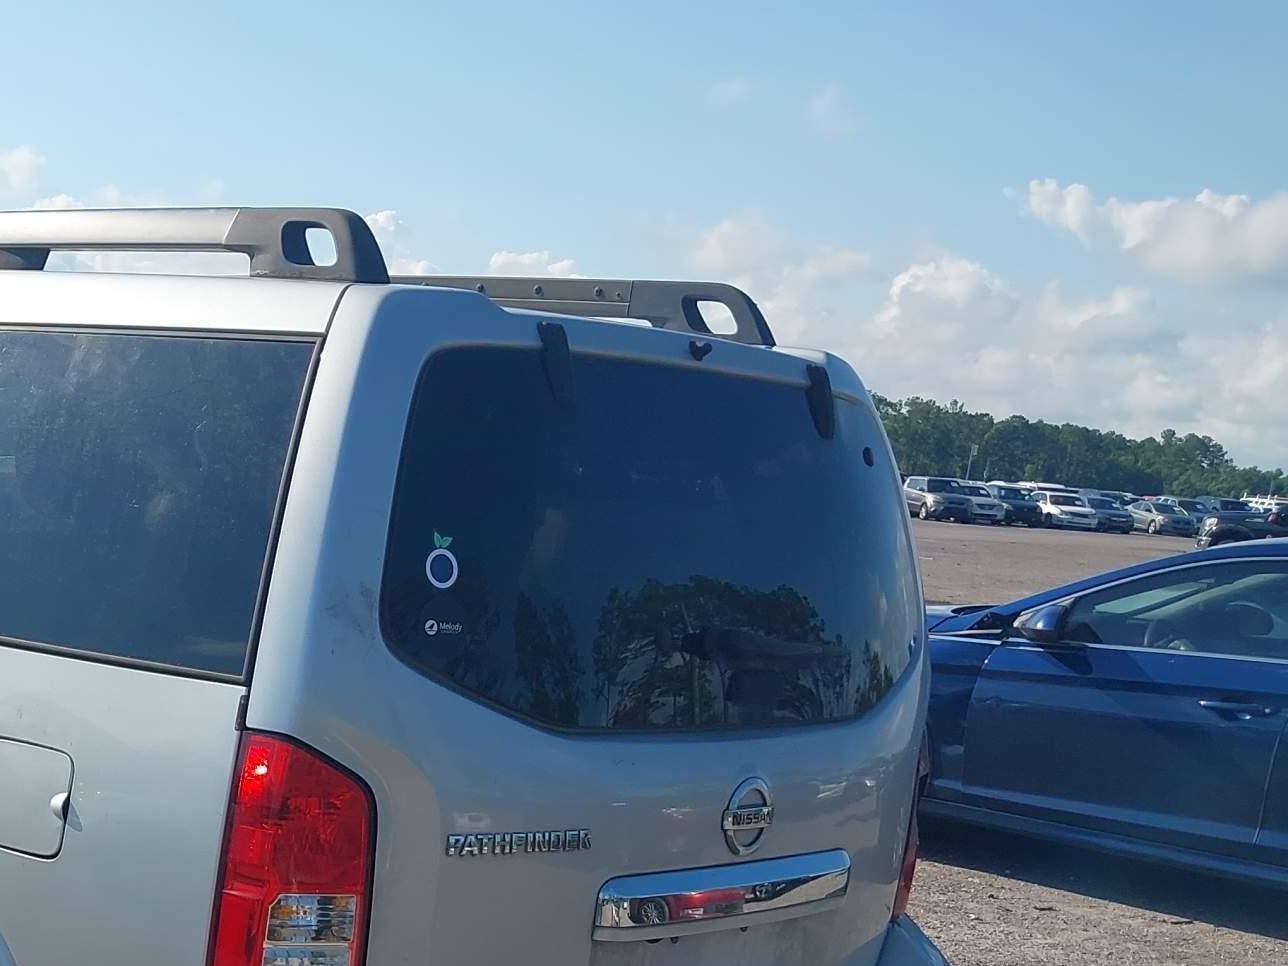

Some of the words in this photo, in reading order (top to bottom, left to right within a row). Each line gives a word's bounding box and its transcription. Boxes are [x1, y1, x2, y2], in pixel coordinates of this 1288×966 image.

[439, 621, 463, 633] Melody
[732, 809, 773, 826] NISSAN
[447, 829, 592, 856] PATHFINDER
